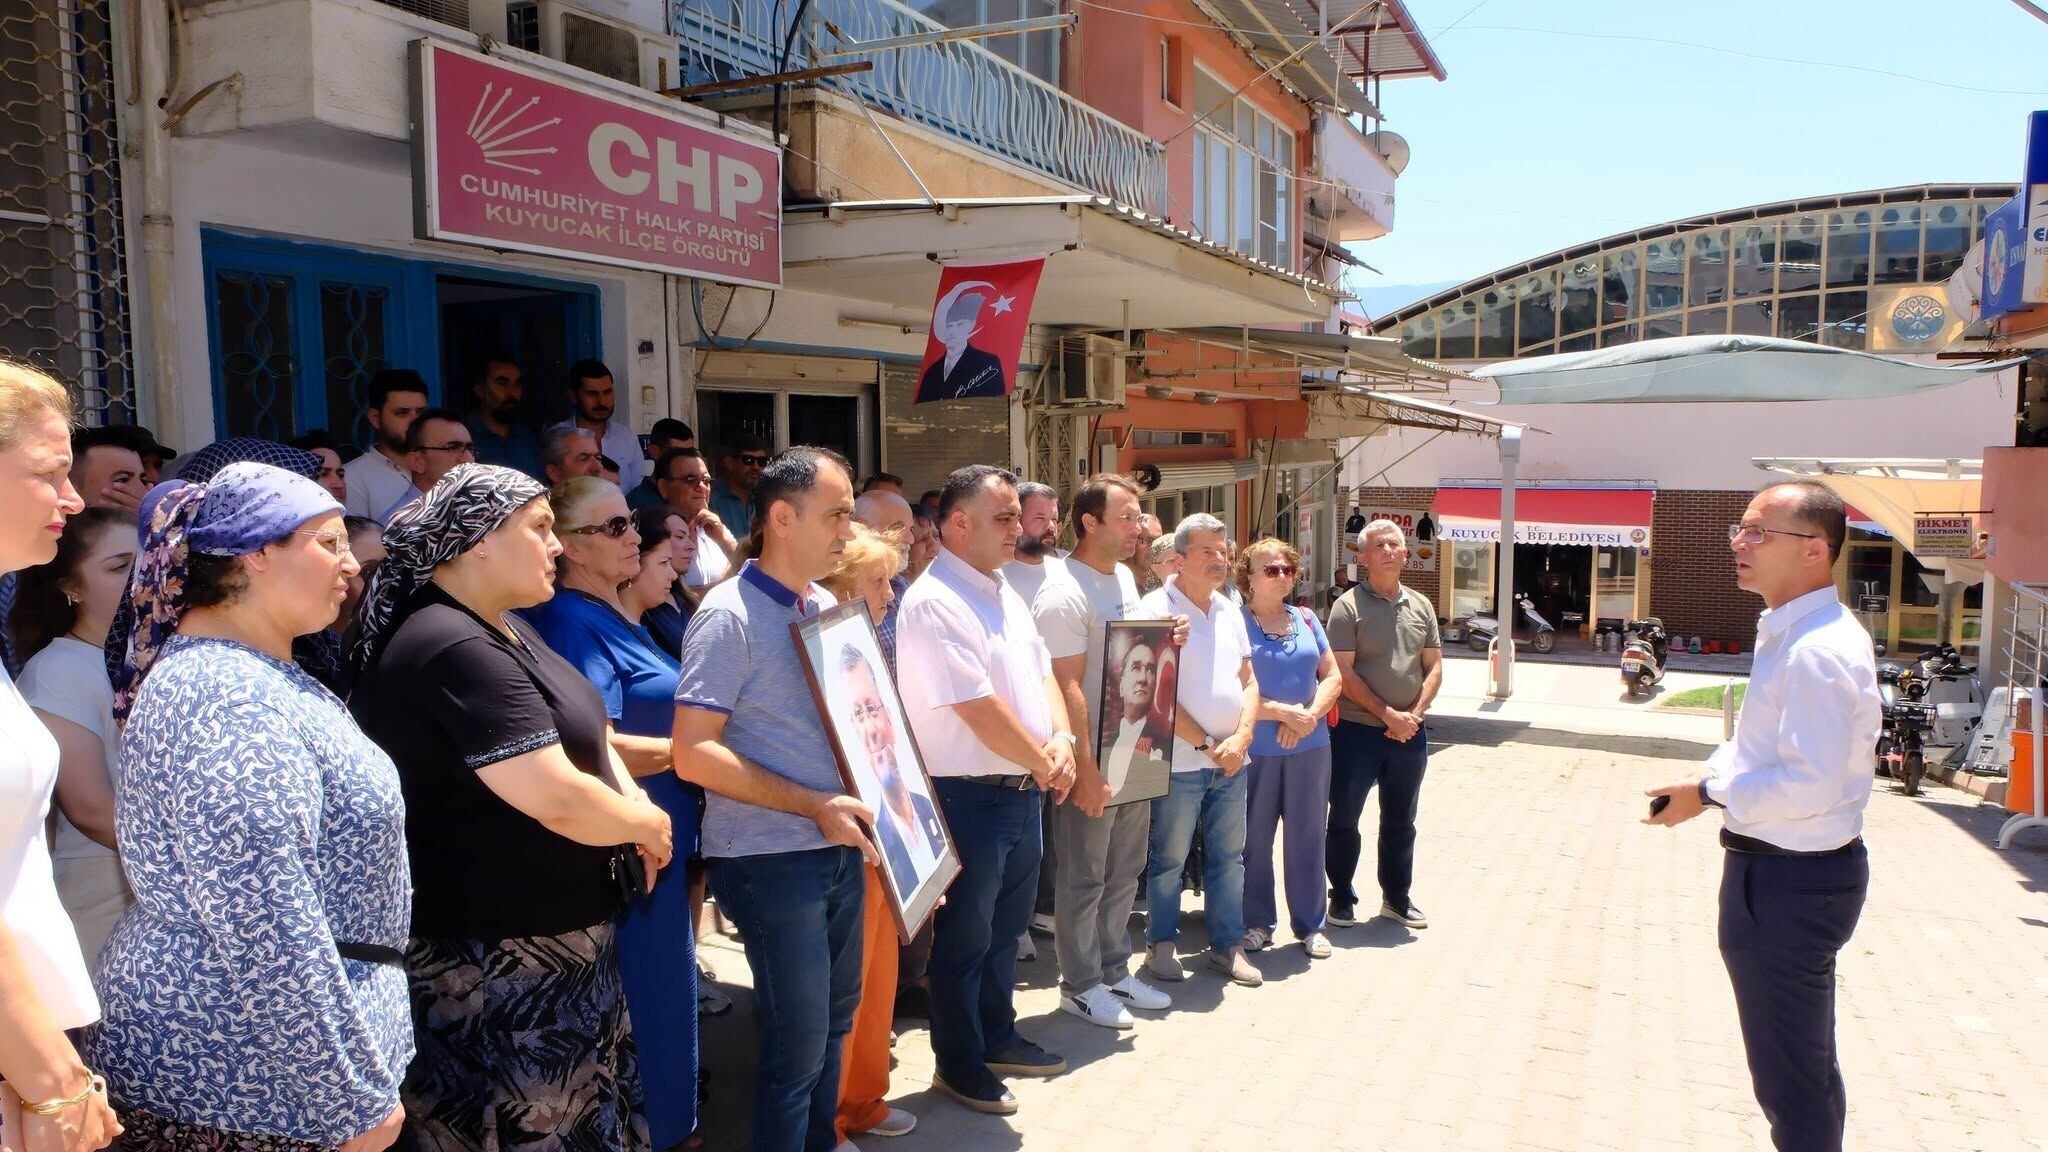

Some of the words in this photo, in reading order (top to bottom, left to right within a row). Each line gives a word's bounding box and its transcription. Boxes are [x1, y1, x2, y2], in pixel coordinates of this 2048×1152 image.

[588, 122, 764, 222] CHP
[460, 174, 629, 222] CUMHURİYET
[636, 209, 691, 235] HALK
[697, 223, 765, 251] PARTİSİ
[485, 203, 612, 242] KUYUCAK
[618, 224, 668, 253] İLÇE
[672, 235, 751, 268] ÖRGÜTÜ
[1451, 528, 1520, 541] KUYUCK
[1527, 531, 1622, 543] BELEDİYESİ
